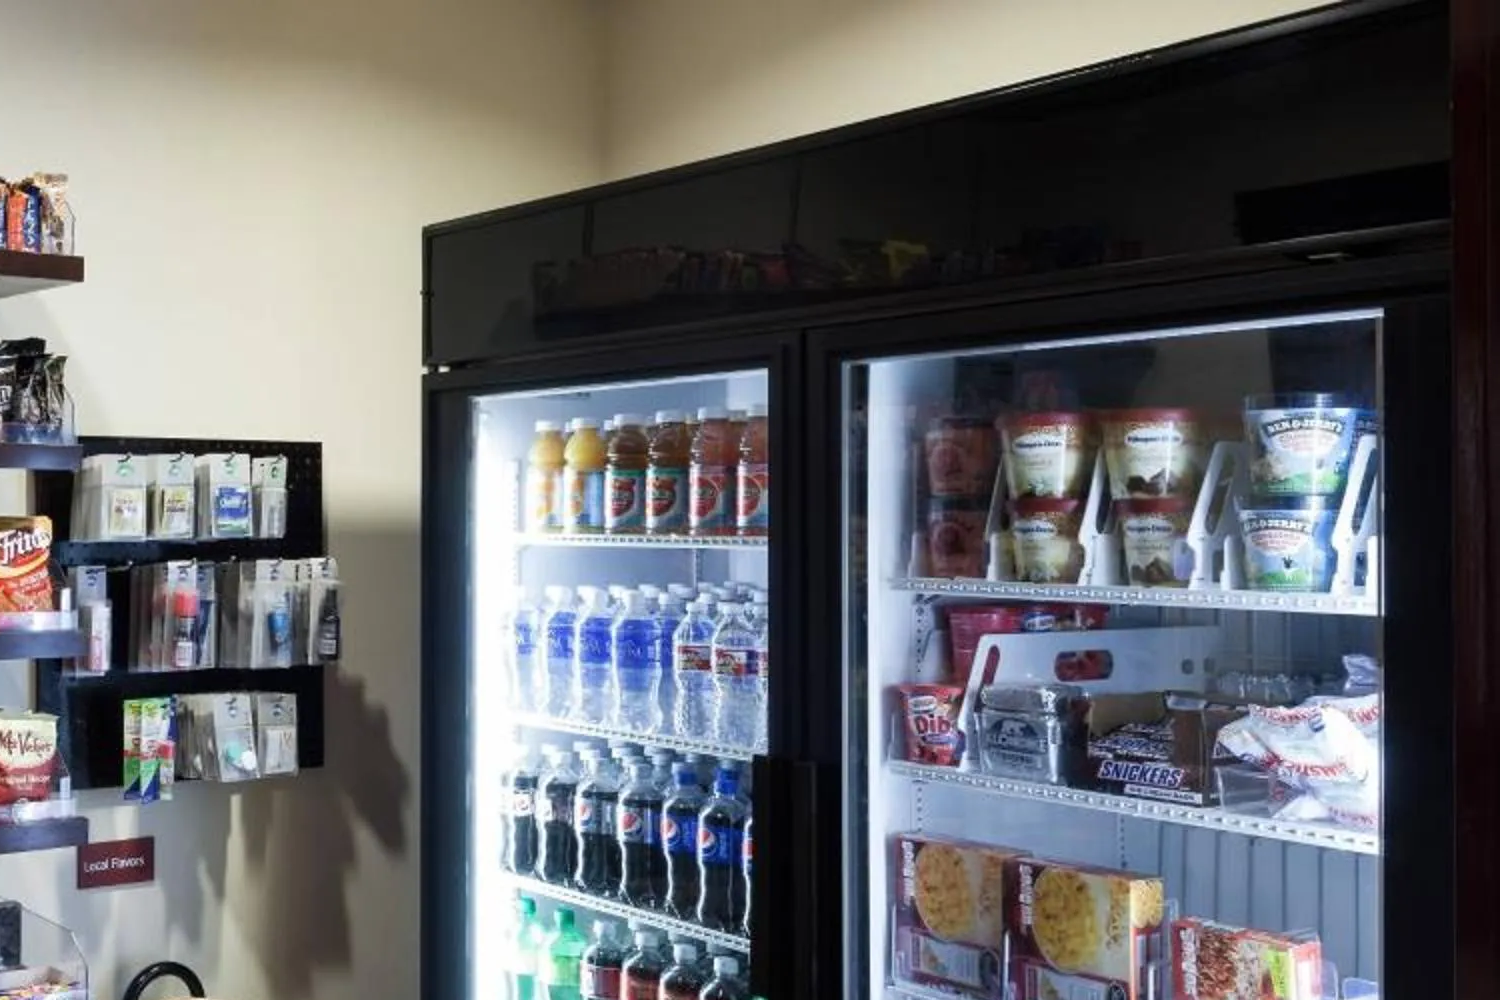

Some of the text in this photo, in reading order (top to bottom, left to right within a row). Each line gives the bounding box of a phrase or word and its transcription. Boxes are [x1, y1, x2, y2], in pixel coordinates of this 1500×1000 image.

[914, 714, 950, 735] Dib
[1100, 760, 1182, 787] SNICKERS
[83, 855, 145, 873] Local Flavors
